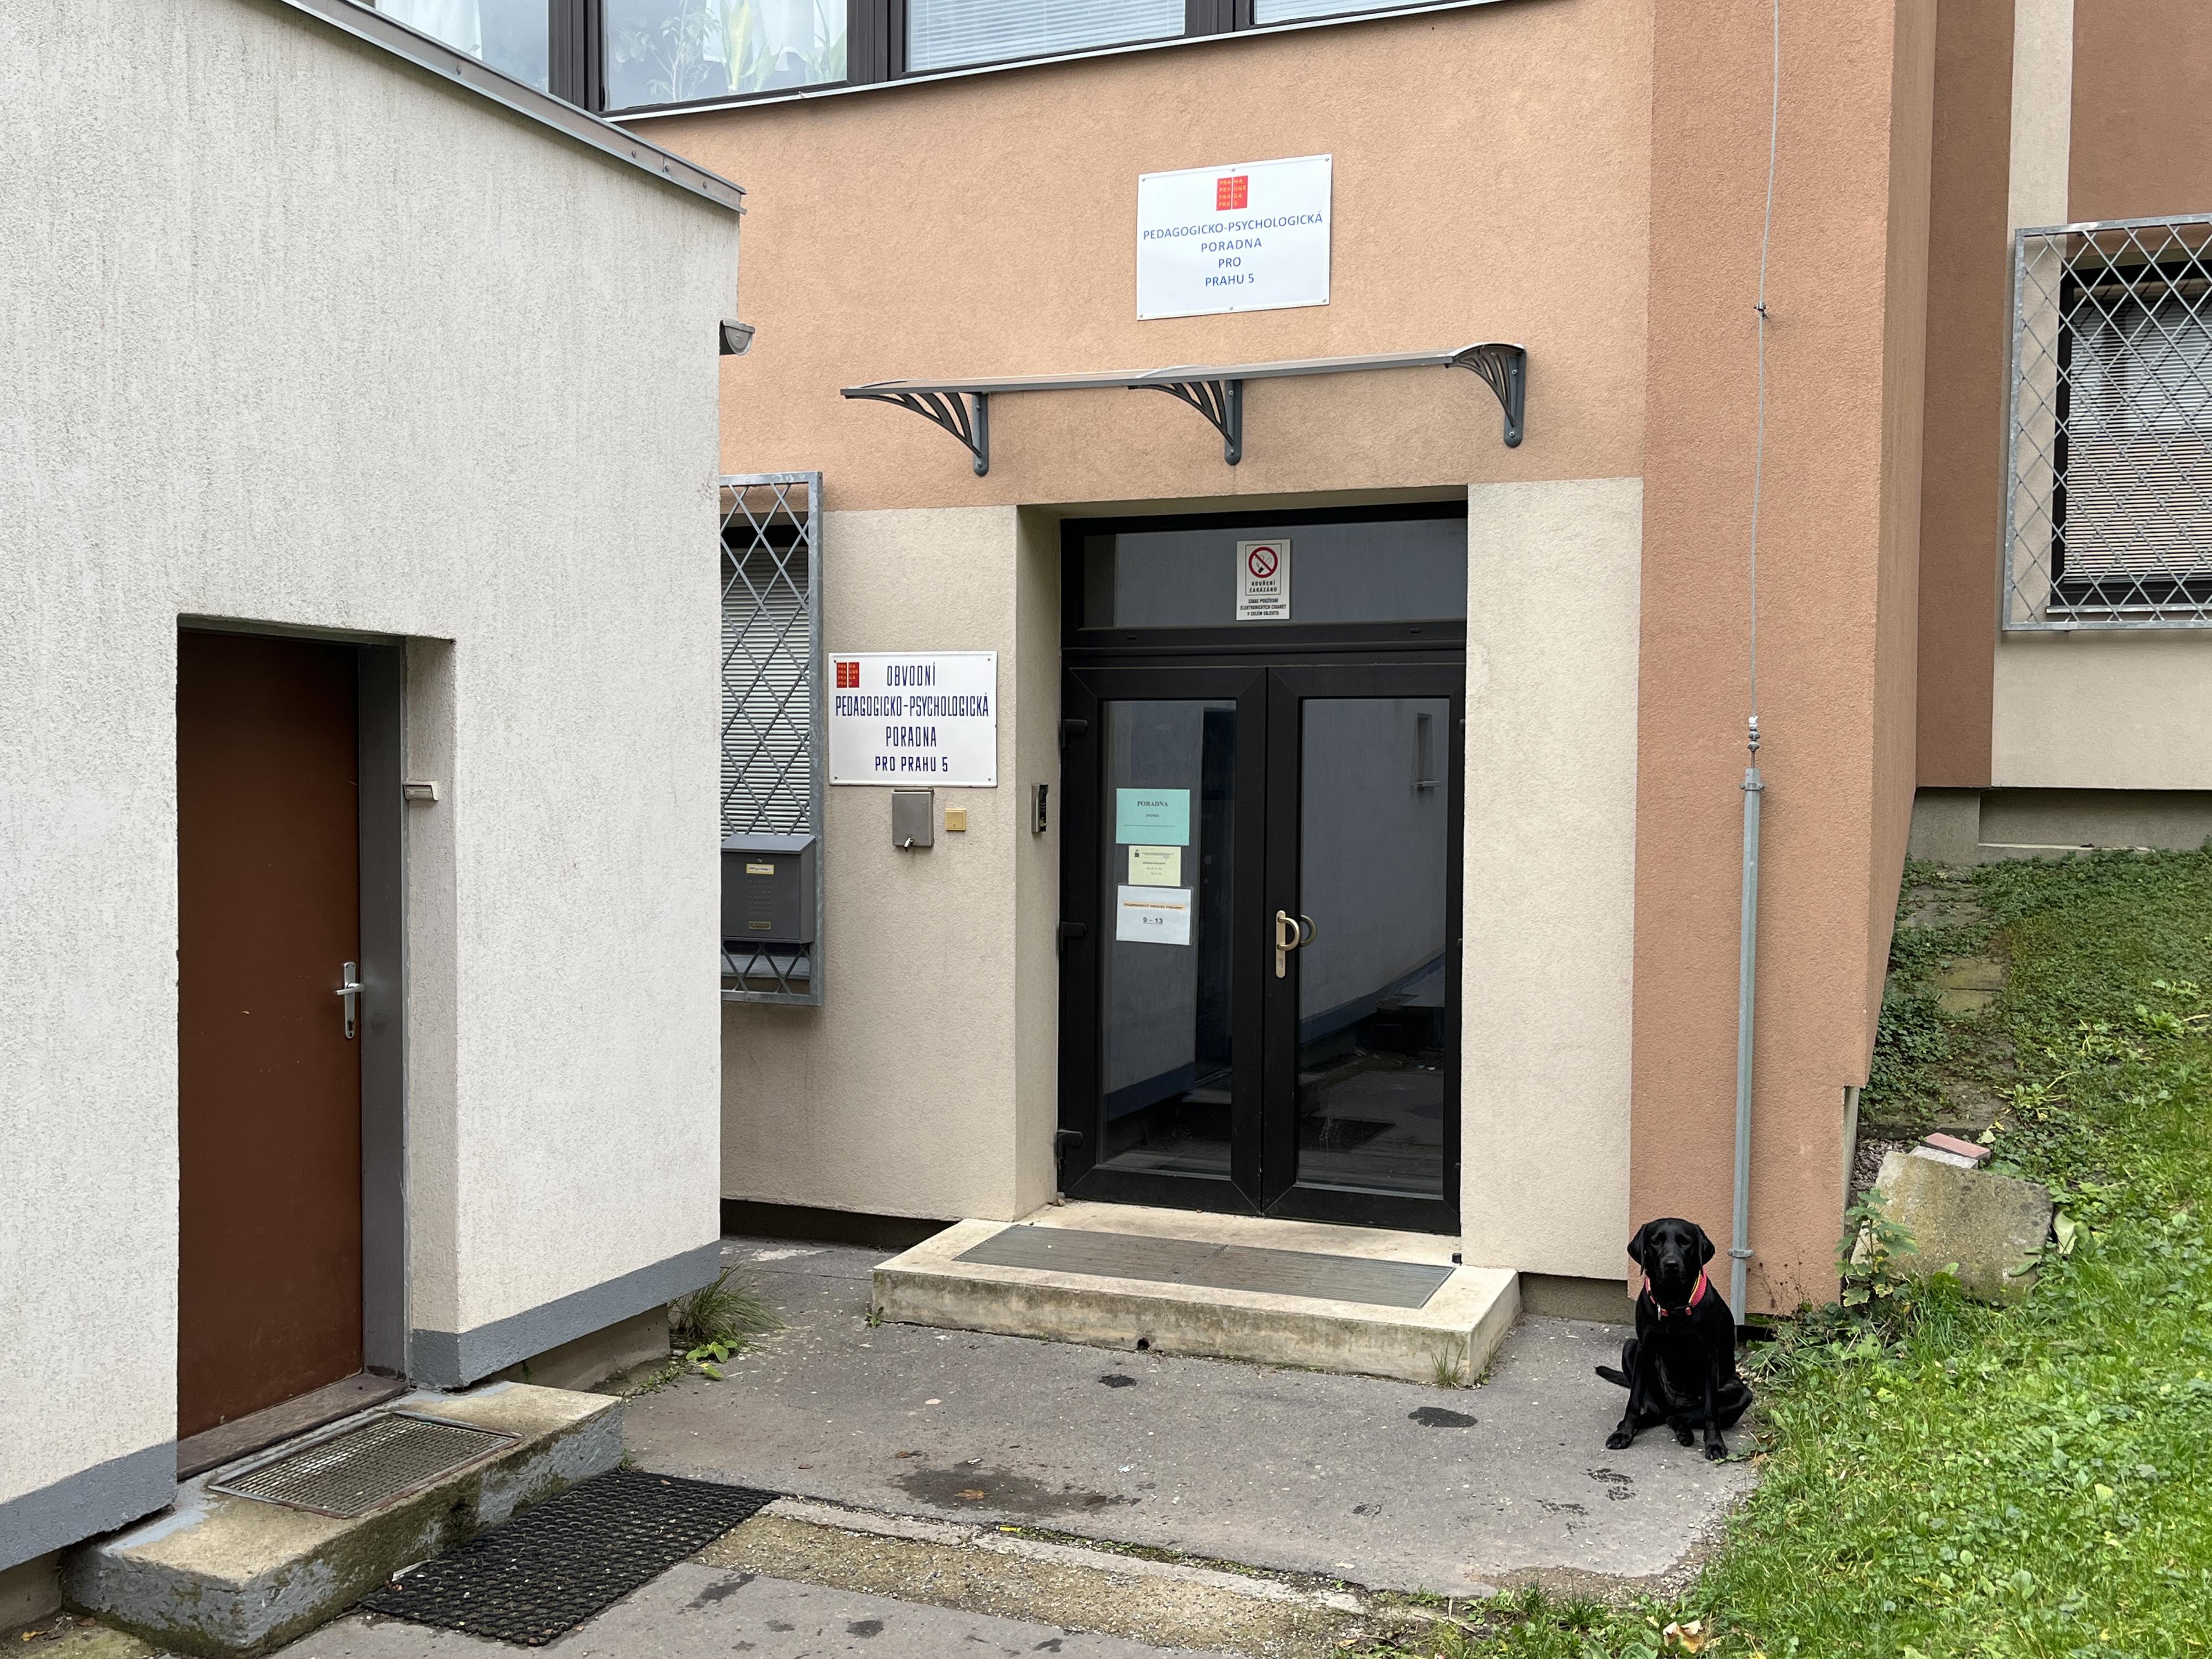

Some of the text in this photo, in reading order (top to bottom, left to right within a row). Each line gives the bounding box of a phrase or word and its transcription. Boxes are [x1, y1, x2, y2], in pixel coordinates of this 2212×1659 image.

[1143, 210, 1323, 240] PEDAGOGICKO-PSYCHOLOGICKÁ
[1201, 238, 1262, 252] PORADNA
[1218, 257, 1241, 268] PRO
[1206, 273, 1254, 287] PRAHU 5
[887, 662, 936, 686] OBVODNÍ
[836, 692, 989, 717] PEDAGOGICKO-PSYCHOLOGICKÁ
[886, 726, 937, 747] PORADNA
[875, 756, 948, 772] PRO PRAHU 5
